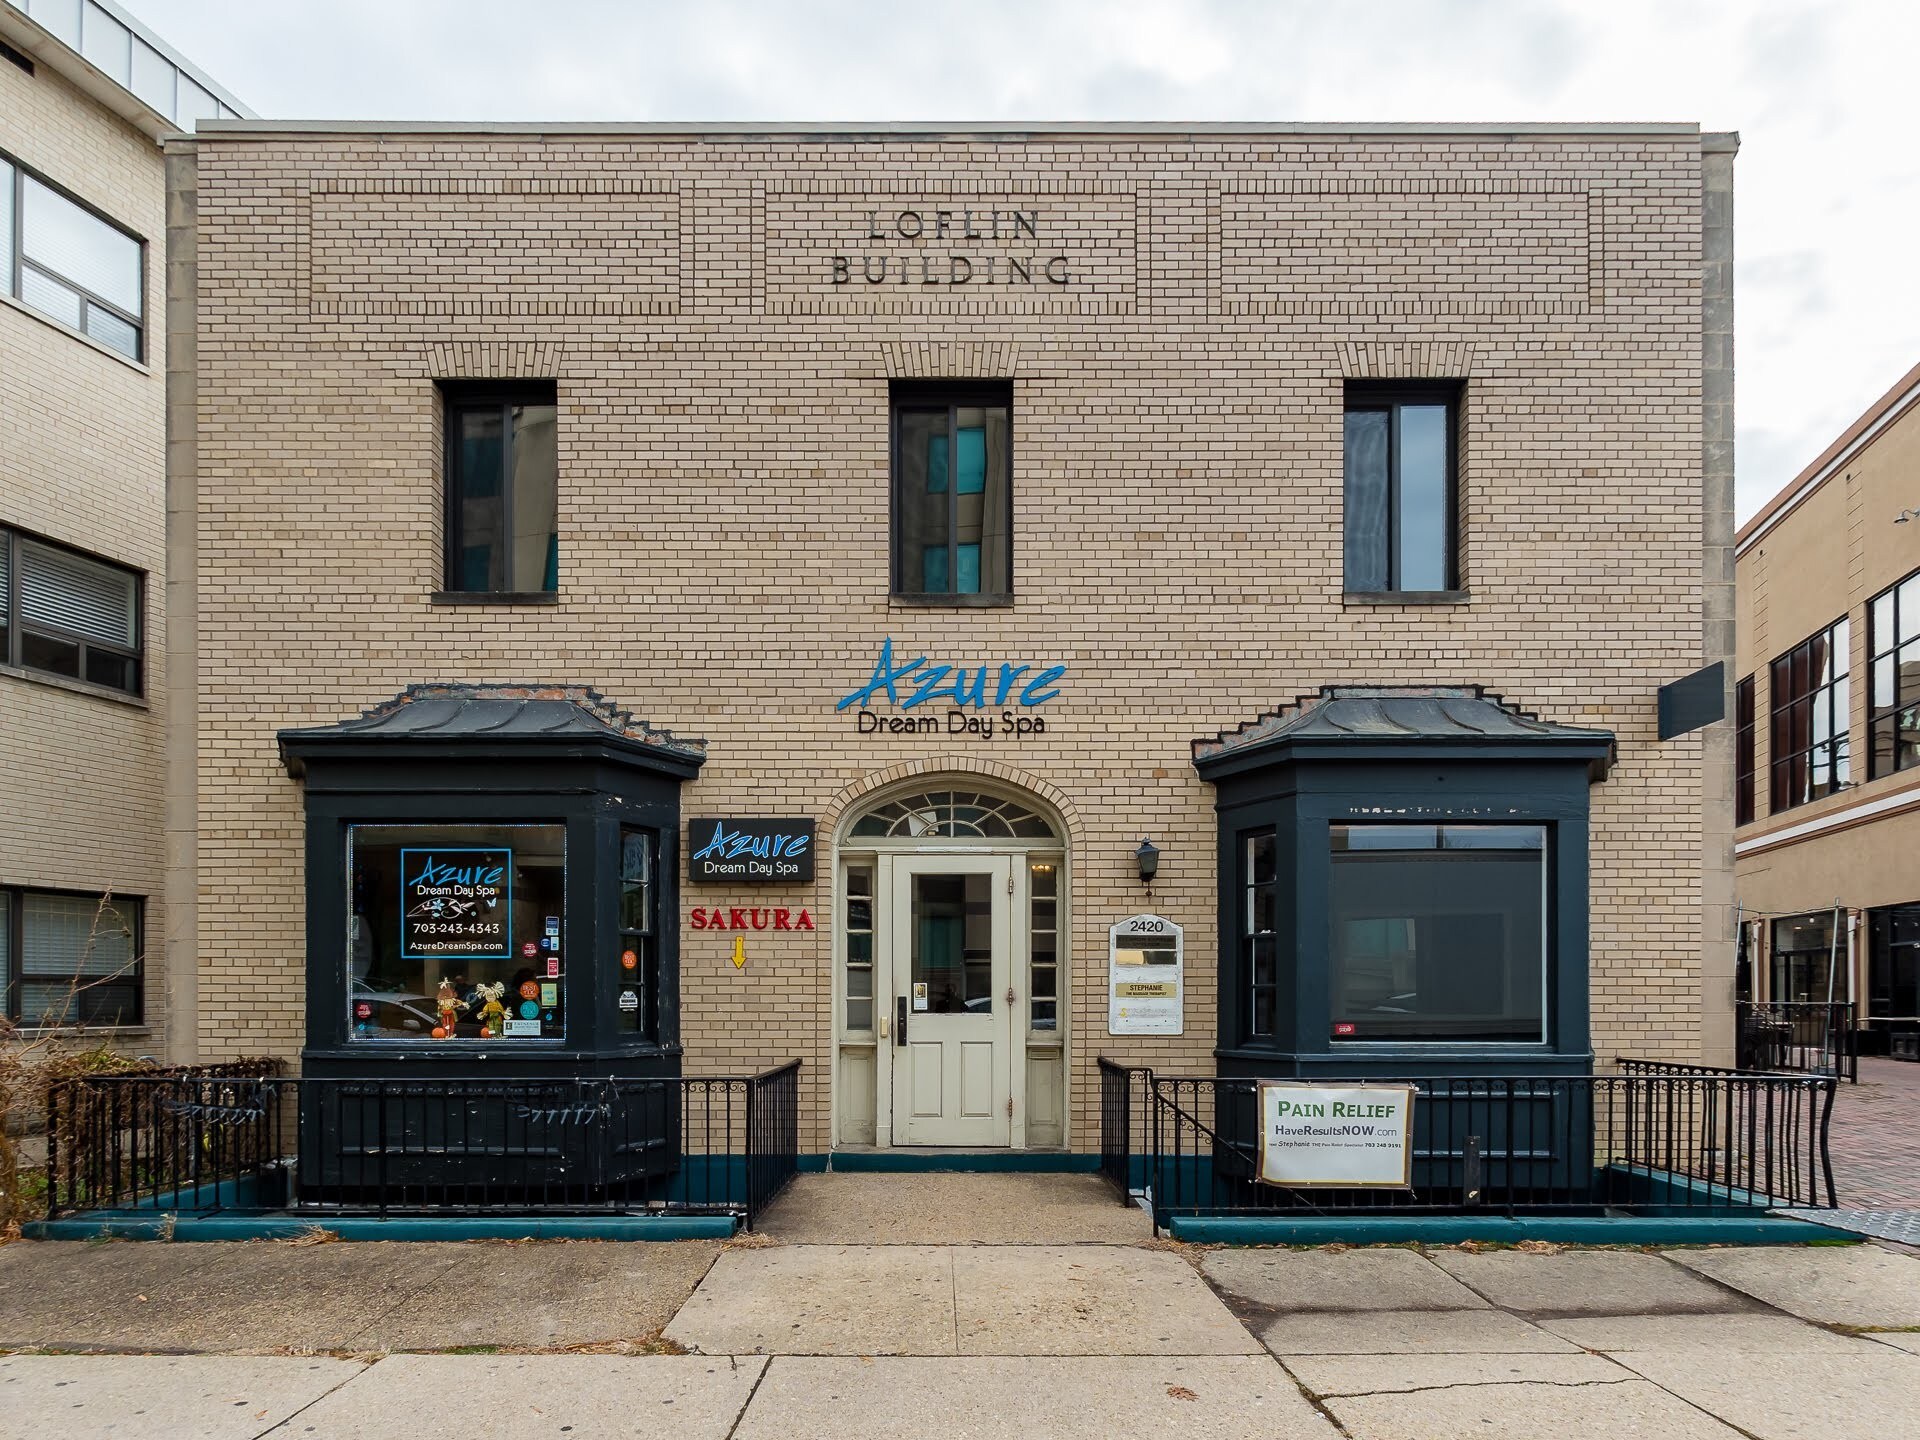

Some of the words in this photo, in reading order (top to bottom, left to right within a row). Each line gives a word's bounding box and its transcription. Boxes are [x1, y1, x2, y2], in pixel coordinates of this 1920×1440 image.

[868, 210, 1039, 239] LOFLIN
[831, 256, 1072, 285] BUILDING
[837, 636, 1066, 711] Azure
[858, 711, 939, 734] Dream
[948, 711, 993, 740] Day
[1001, 711, 1045, 740] Spa
[693, 821, 810, 859] Azure
[408, 855, 504, 886] Azure
[704, 861, 746, 874] Dream
[749, 861, 773, 876] Day
[775, 861, 799, 876] Spa
[417, 885, 452, 896] Dream
[454, 885, 474, 898] Day
[476, 885, 495, 898] Spa
[691, 907, 815, 930] SAKURA
[1130, 920, 1164, 932] 2420
[413, 923, 500, 934] 703-243-4343
[410, 941, 503, 951] AzureDreamSpa.com
[1278, 1100, 1325, 1118] PAIN
[1332, 1101, 1396, 1119] RELIEF
[1275, 1125, 1397, 1137] HaveResultsNOW.com
[1278, 1140, 1310, 1148] Stephanie
